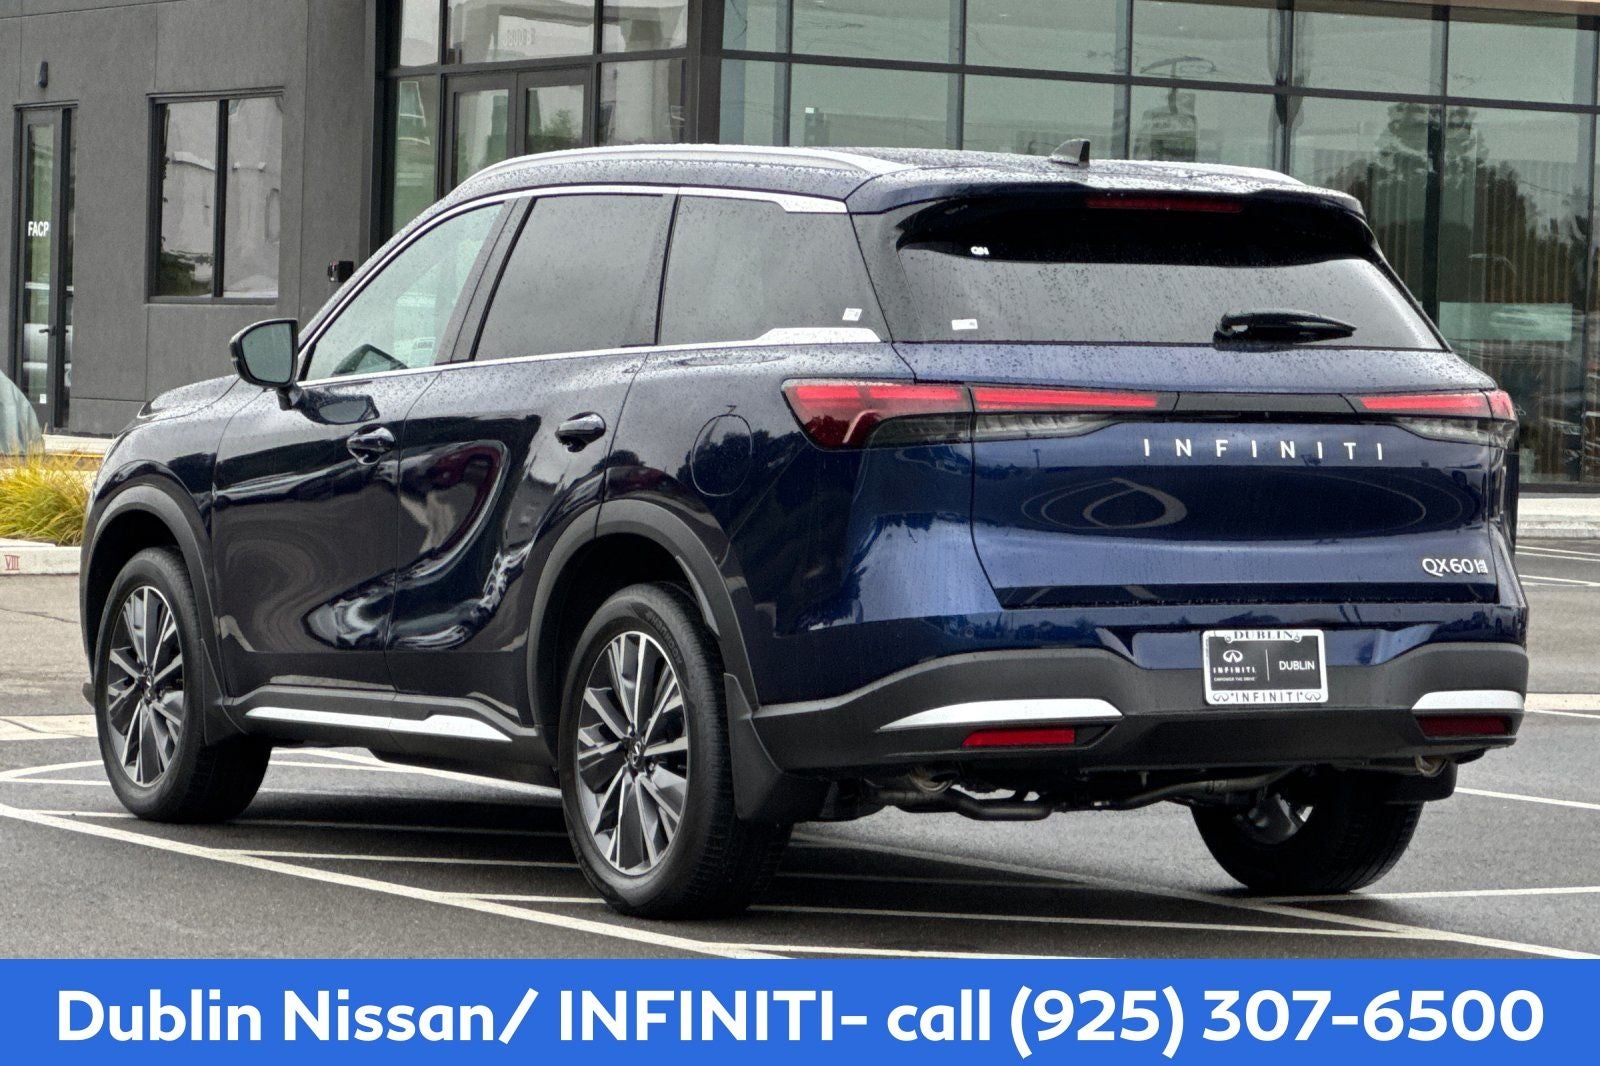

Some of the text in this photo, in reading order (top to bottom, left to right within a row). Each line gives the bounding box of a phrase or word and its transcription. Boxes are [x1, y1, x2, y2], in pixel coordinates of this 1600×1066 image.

[27, 220, 50, 237] FACP
[1143, 438, 1384, 461] INFINITI
[1421, 557, 1475, 577] QX60
[1233, 630, 1294, 640] DUBLIN
[1213, 666, 1256, 674] INFINITI
[1278, 660, 1316, 671] DUBLIN
[1235, 691, 1300, 703] INFINITI
